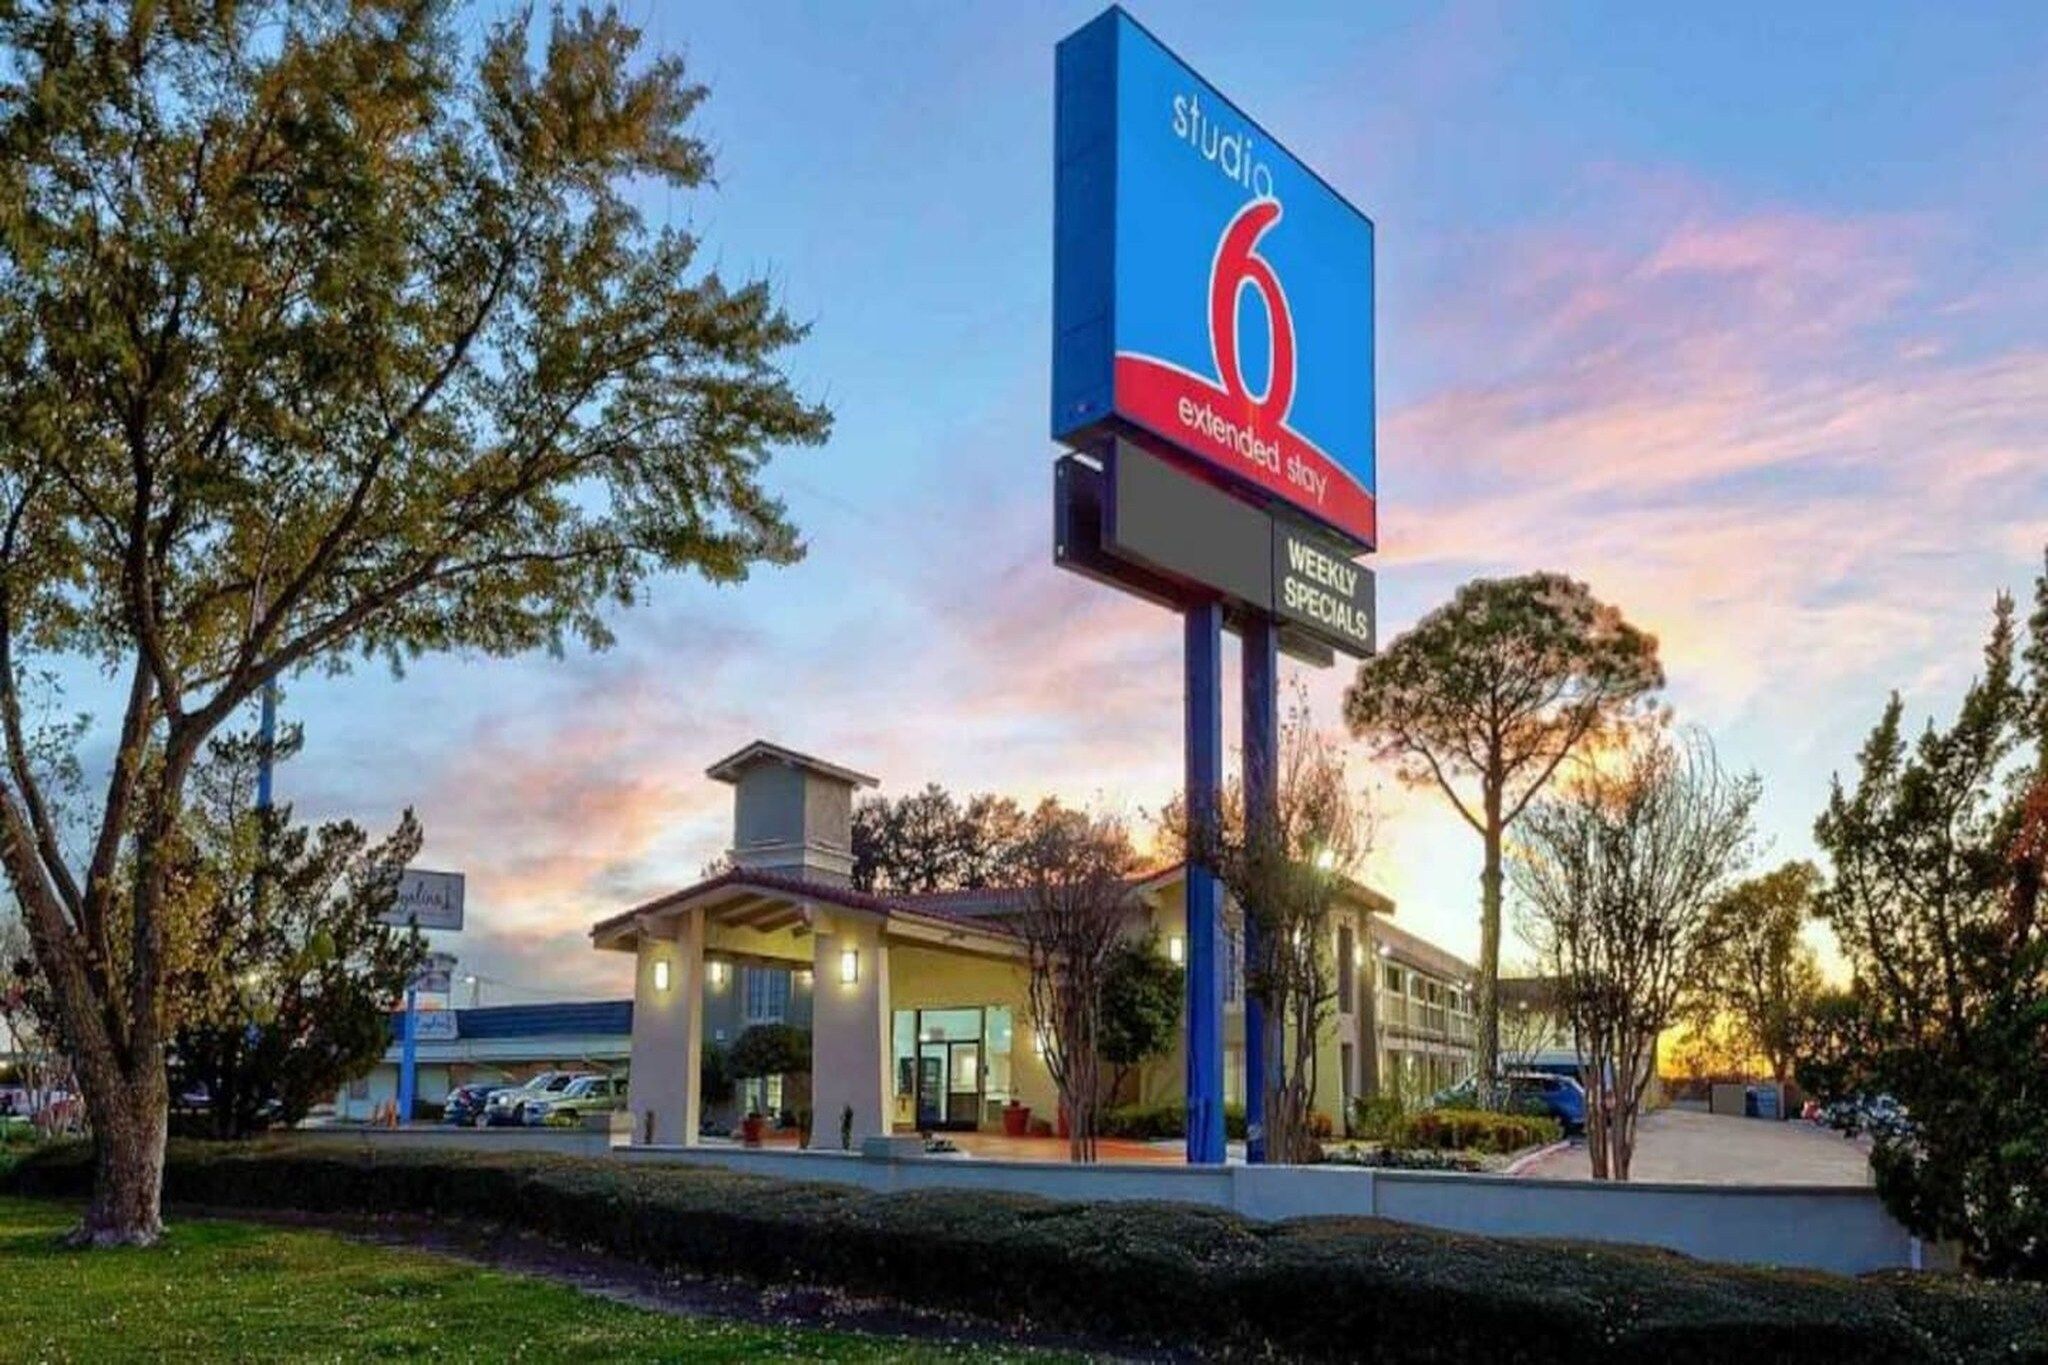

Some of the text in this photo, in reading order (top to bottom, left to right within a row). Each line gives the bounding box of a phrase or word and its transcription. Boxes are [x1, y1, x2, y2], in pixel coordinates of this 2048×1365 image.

[1173, 94, 1273, 199] studio
[1208, 197, 1297, 424] 6
[1178, 396, 1328, 504] extended stay
[1284, 575, 1367, 640] SPECIALS
[1287, 538, 1358, 597] WEEKLY
